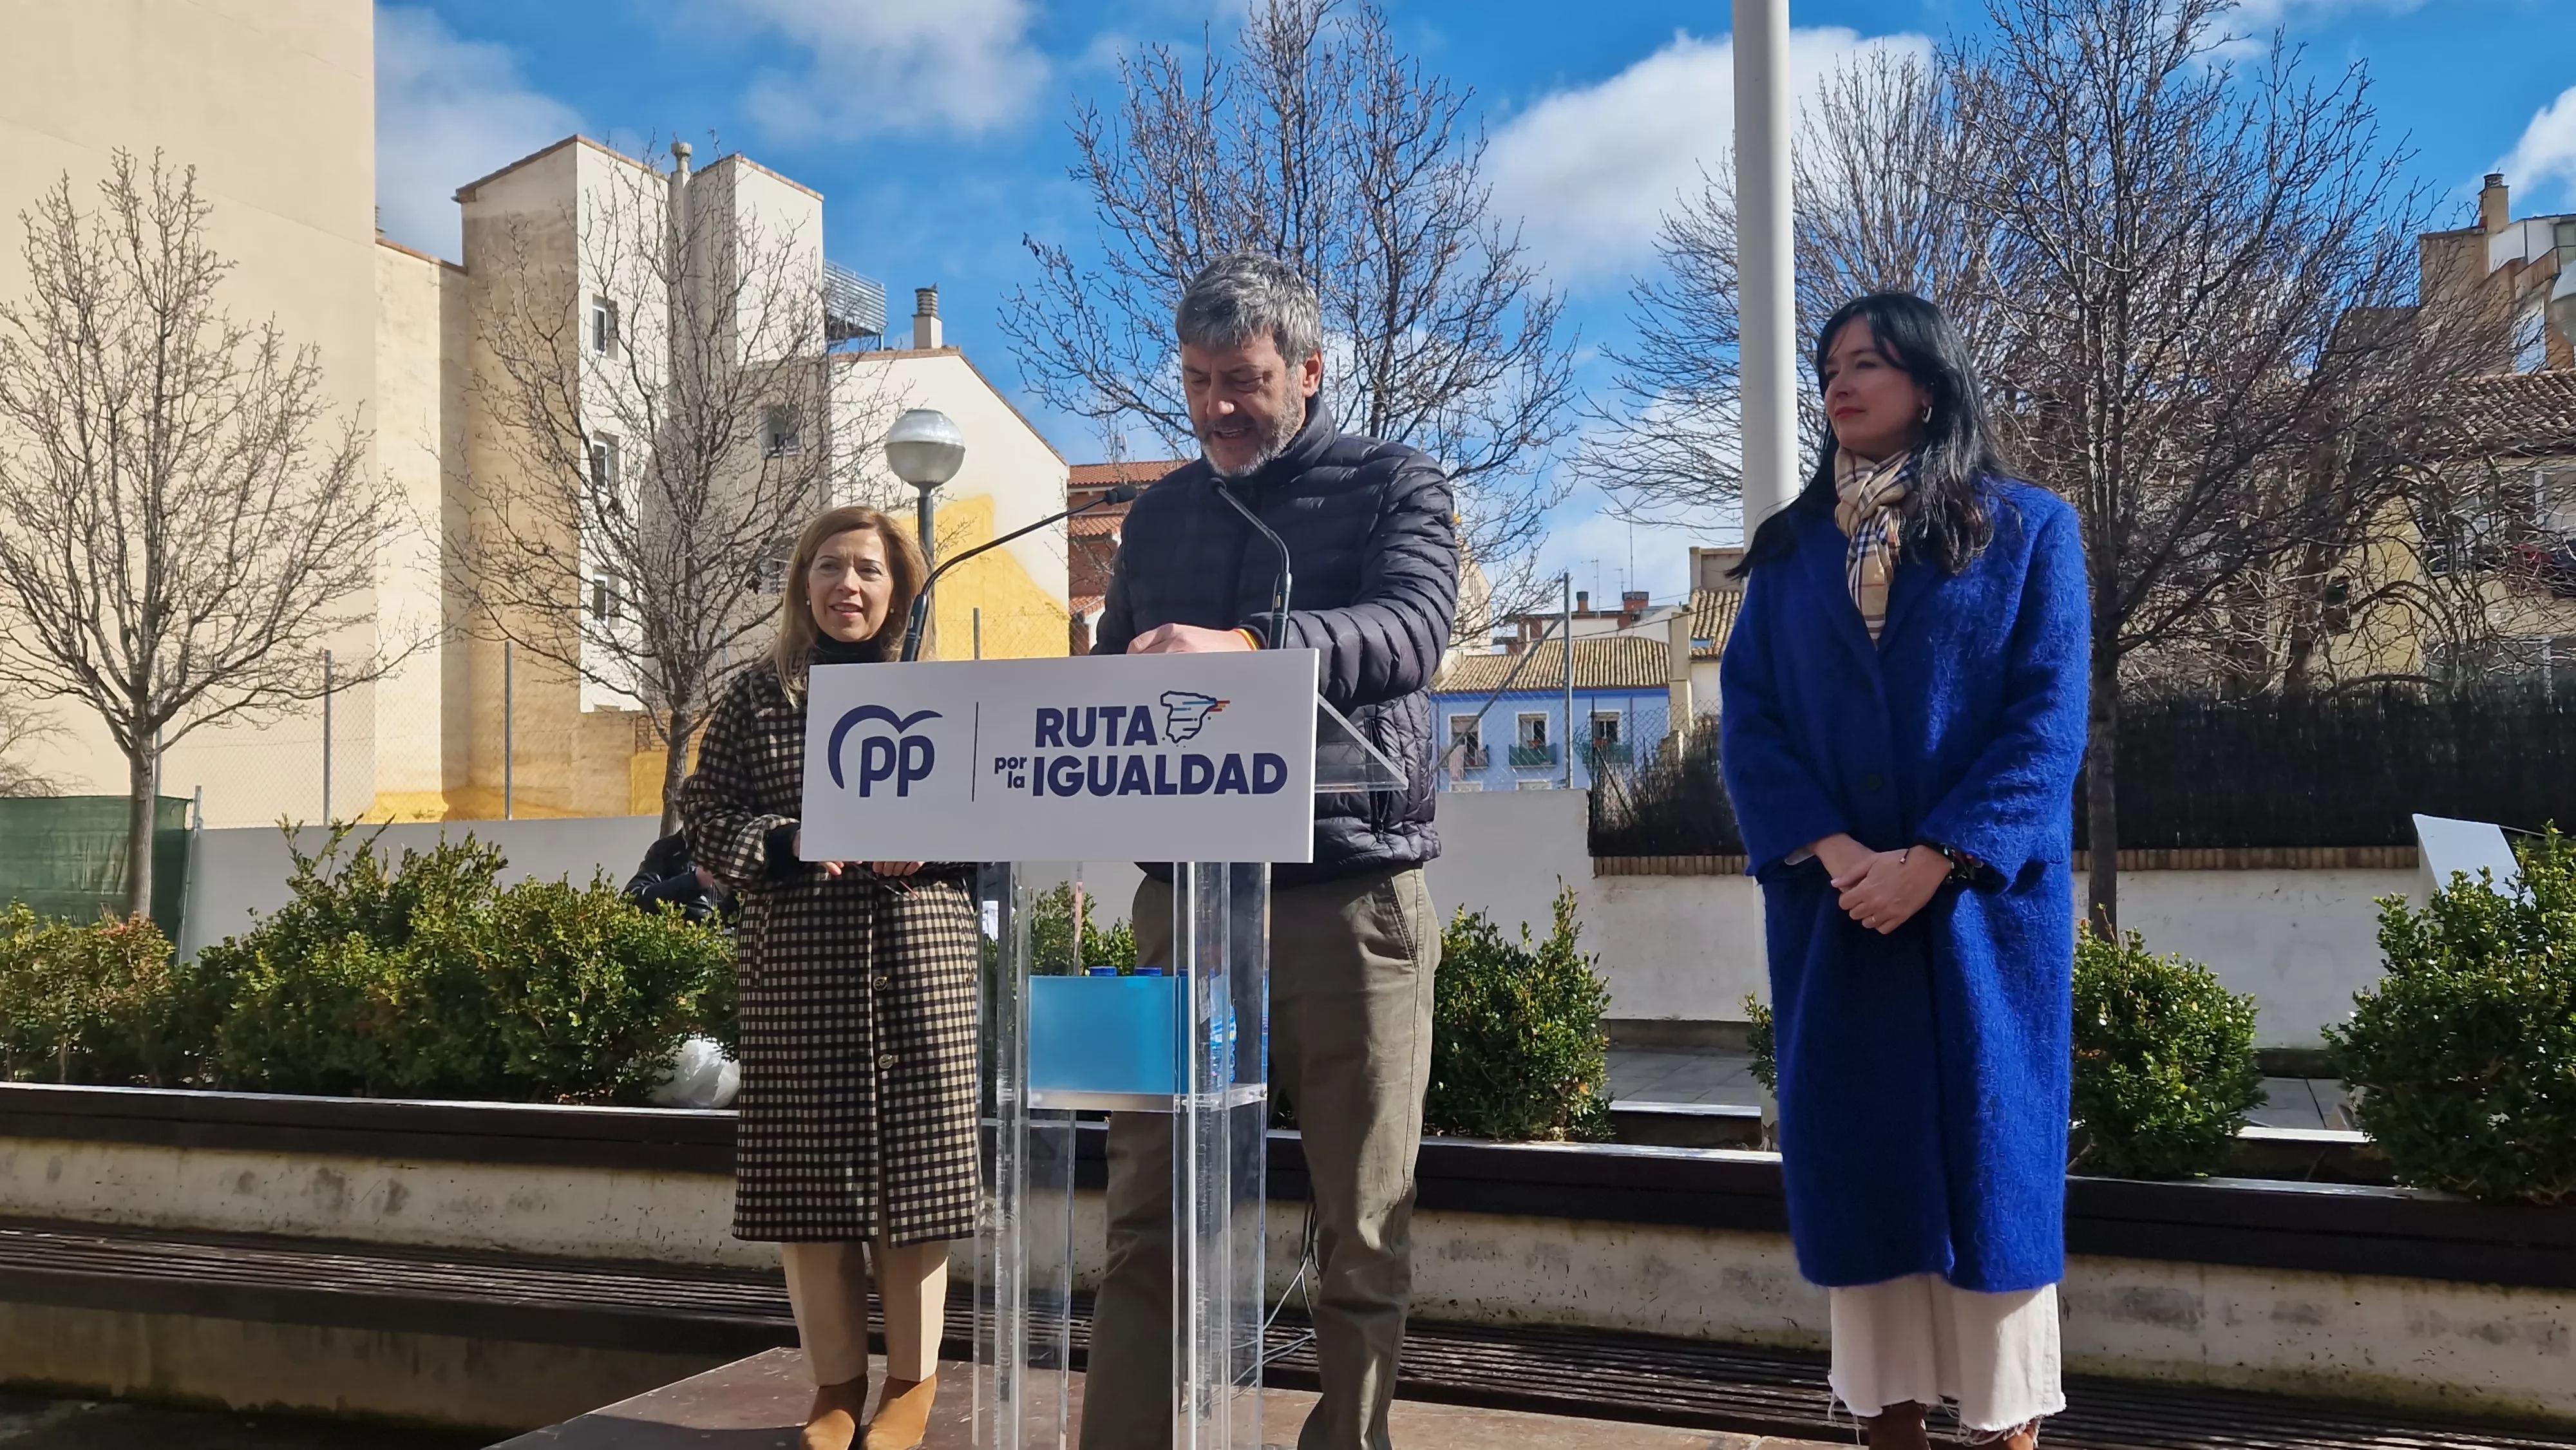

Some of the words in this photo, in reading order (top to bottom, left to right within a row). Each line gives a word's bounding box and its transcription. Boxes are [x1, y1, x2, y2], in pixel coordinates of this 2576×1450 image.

[1035, 705, 1159, 748] RUTA
[858, 735, 936, 798] pp
[994, 757, 1027, 775] por
[1007, 770, 1025, 789] la
[1032, 753, 1289, 797] IGUALDAD
